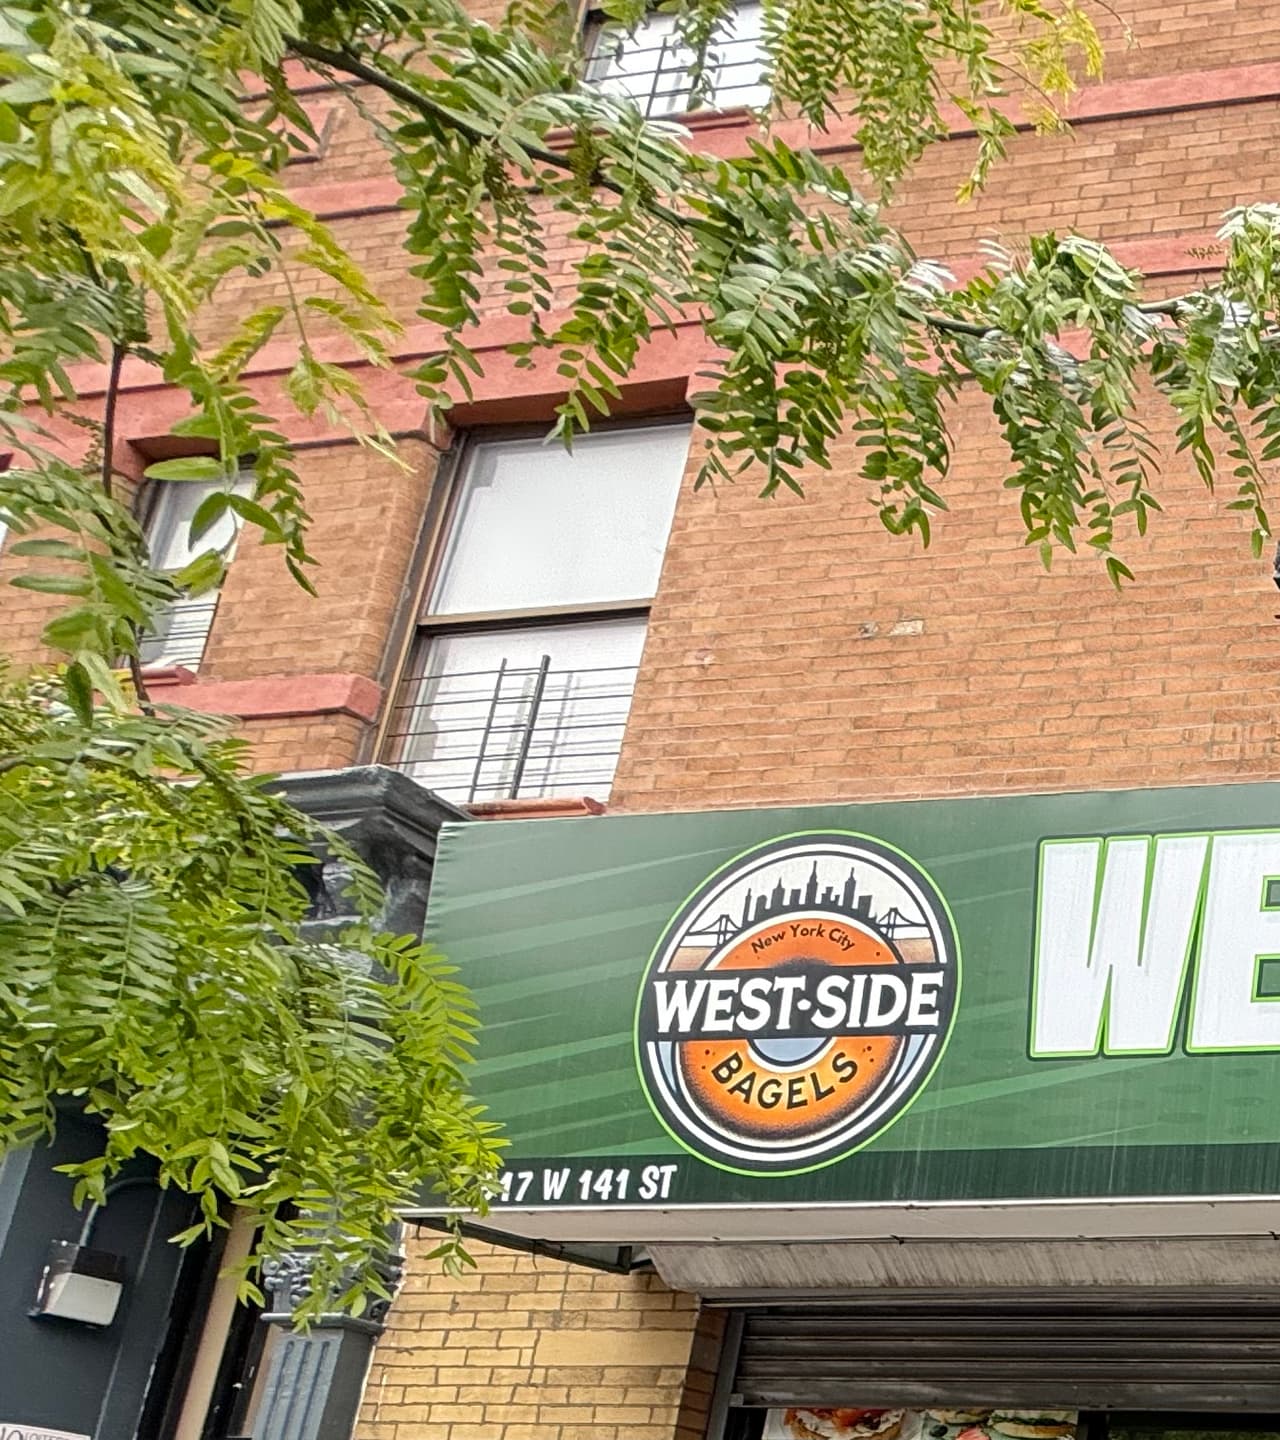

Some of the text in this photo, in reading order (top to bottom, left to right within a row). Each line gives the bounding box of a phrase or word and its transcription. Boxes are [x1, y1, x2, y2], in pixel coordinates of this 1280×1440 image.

[751, 923, 856, 954] New York City
[711, 1051, 859, 1110] BAGELS
[543, 1167, 571, 1200] W
[579, 1168, 630, 1201] 141
[638, 1164, 678, 1200] ST
